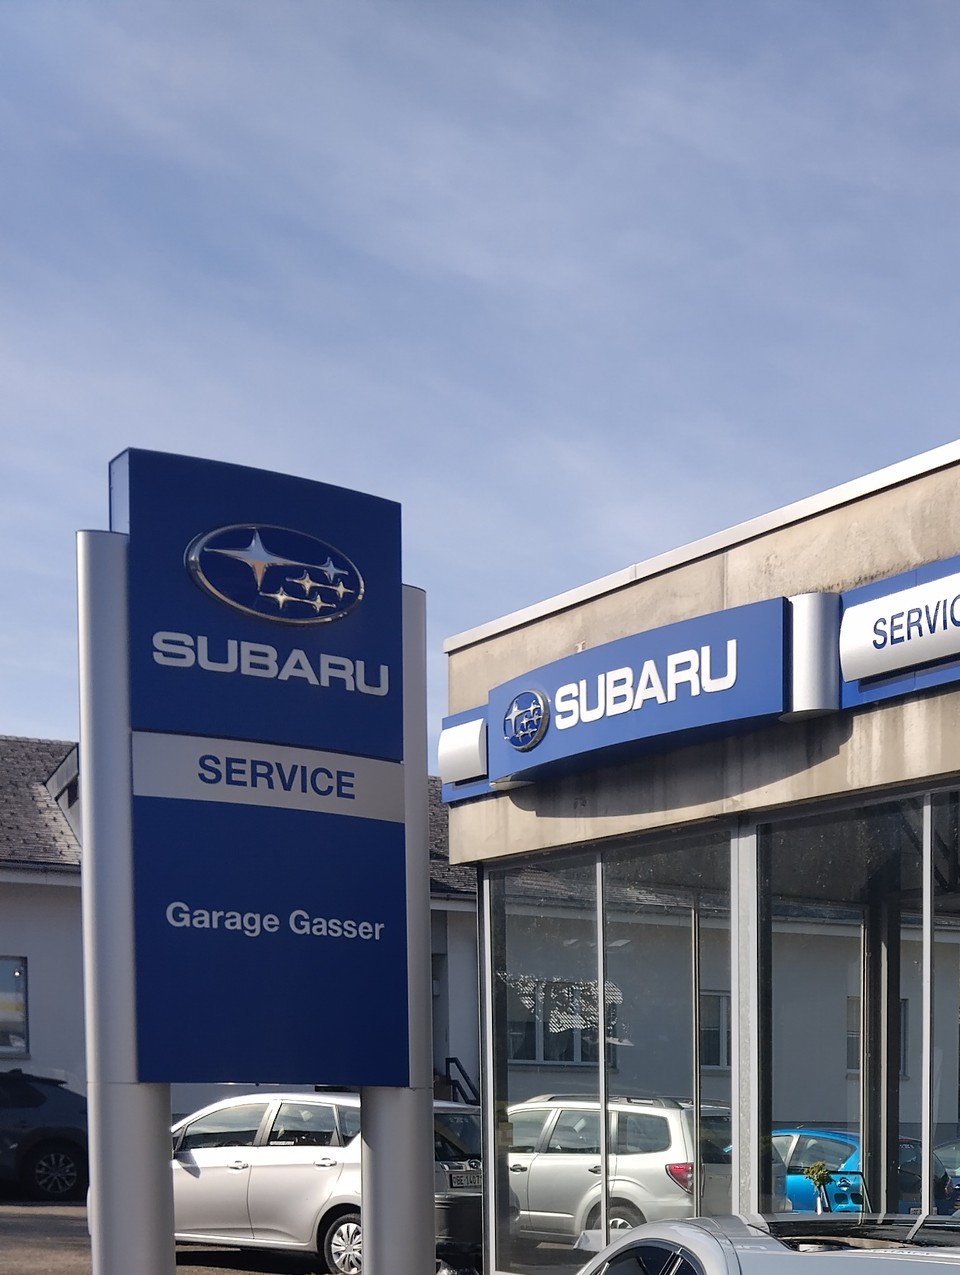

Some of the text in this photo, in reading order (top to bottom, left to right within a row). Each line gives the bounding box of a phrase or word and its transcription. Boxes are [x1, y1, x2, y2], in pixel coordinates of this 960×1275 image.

[152, 630, 390, 697] SUBARU
[554, 638, 738, 730] SUBARU
[197, 754, 356, 801] SERVICE
[165, 901, 385, 941] Garage Gasser
